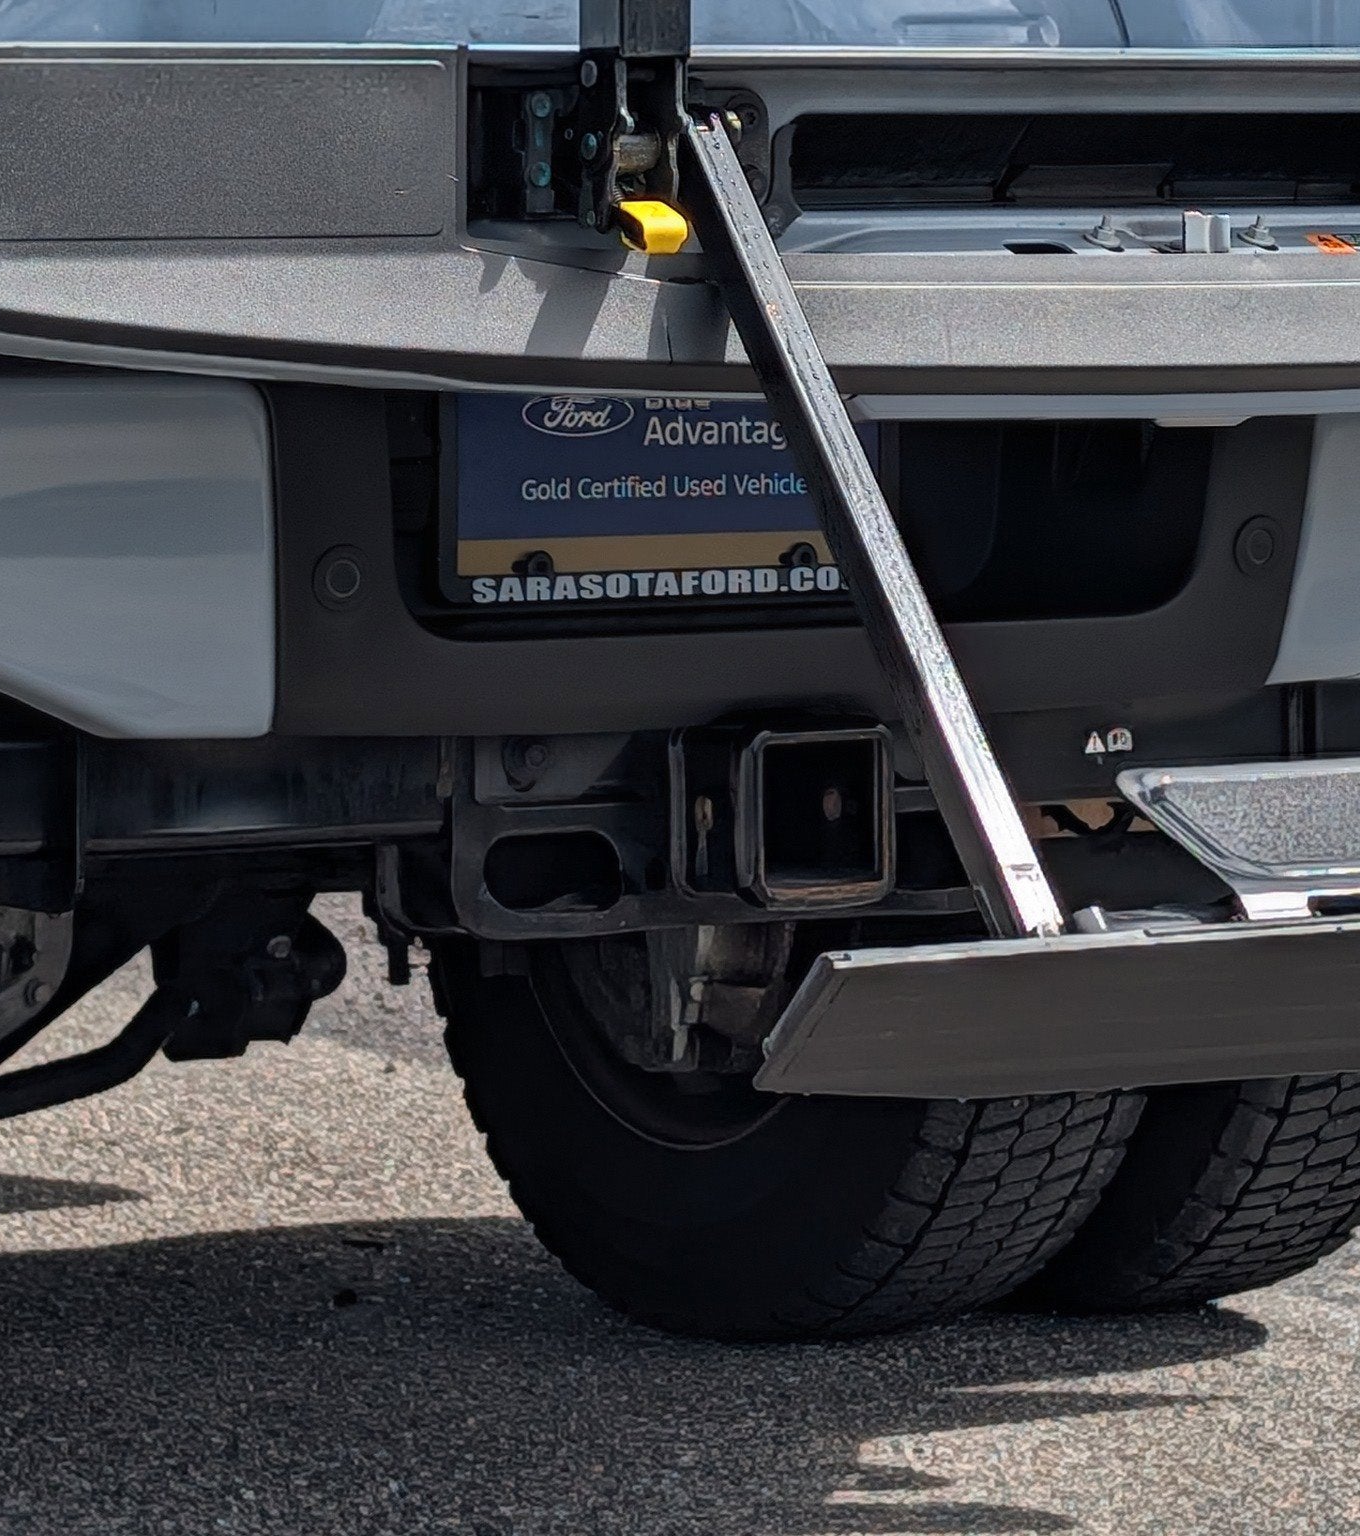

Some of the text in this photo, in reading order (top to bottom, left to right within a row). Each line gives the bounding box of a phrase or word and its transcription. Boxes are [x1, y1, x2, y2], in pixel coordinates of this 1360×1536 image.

[643, 415, 788, 451] Advantag
[521, 477, 571, 502] Gold
[576, 474, 666, 500] Certified
[673, 473, 727, 498] Used
[472, 566, 850, 604] SARASOTAFORD.CO
